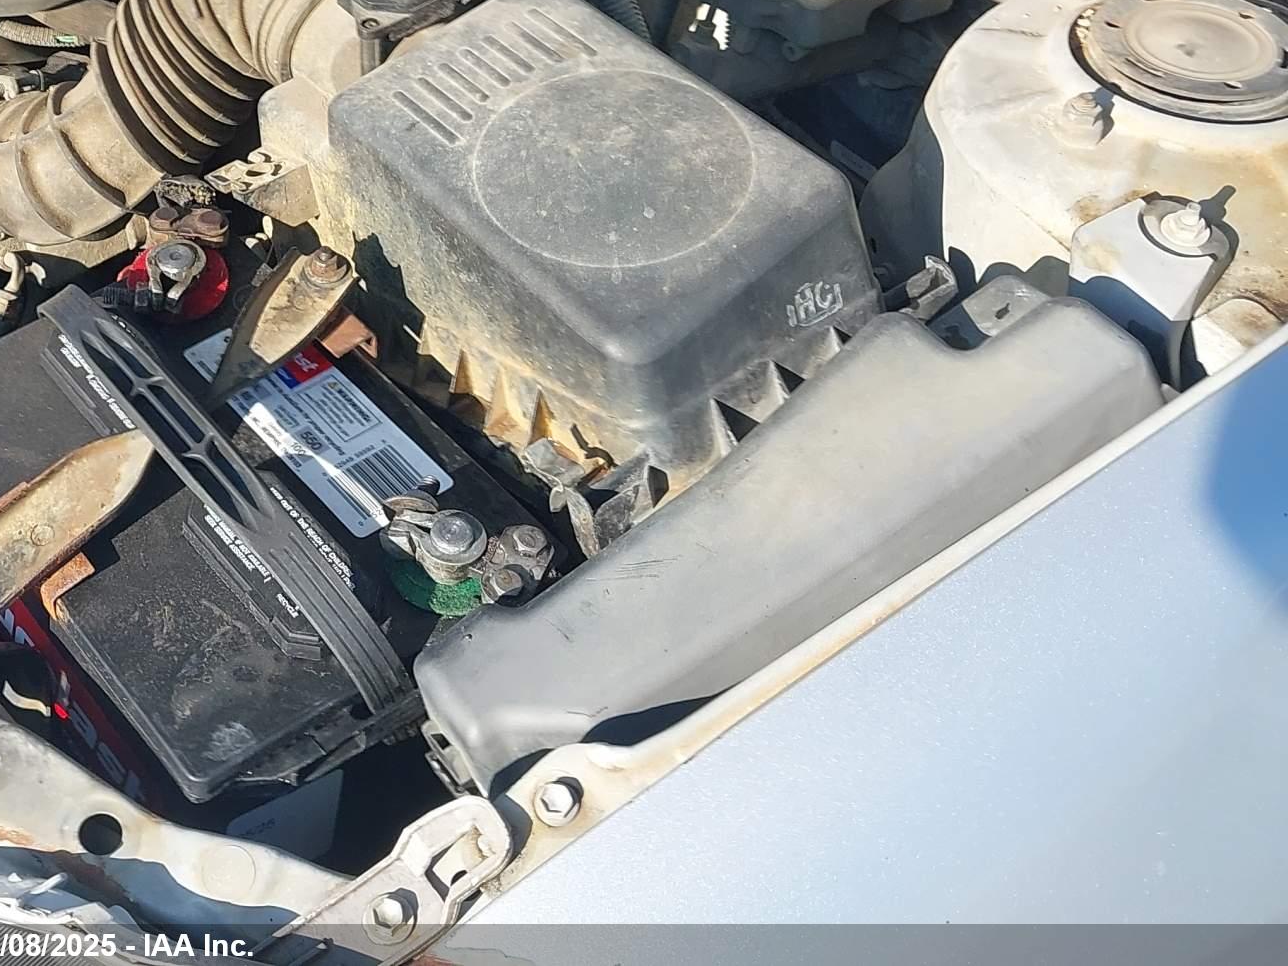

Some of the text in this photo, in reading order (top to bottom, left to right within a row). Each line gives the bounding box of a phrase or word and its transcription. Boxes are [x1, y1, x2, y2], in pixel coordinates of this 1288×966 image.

[298, 429, 323, 452] 550
[288, 508, 300, 520] OF
[304, 526, 324, 546] REACH
[320, 543, 332, 554] OF
[274, 592, 299, 619] RECYCLE
